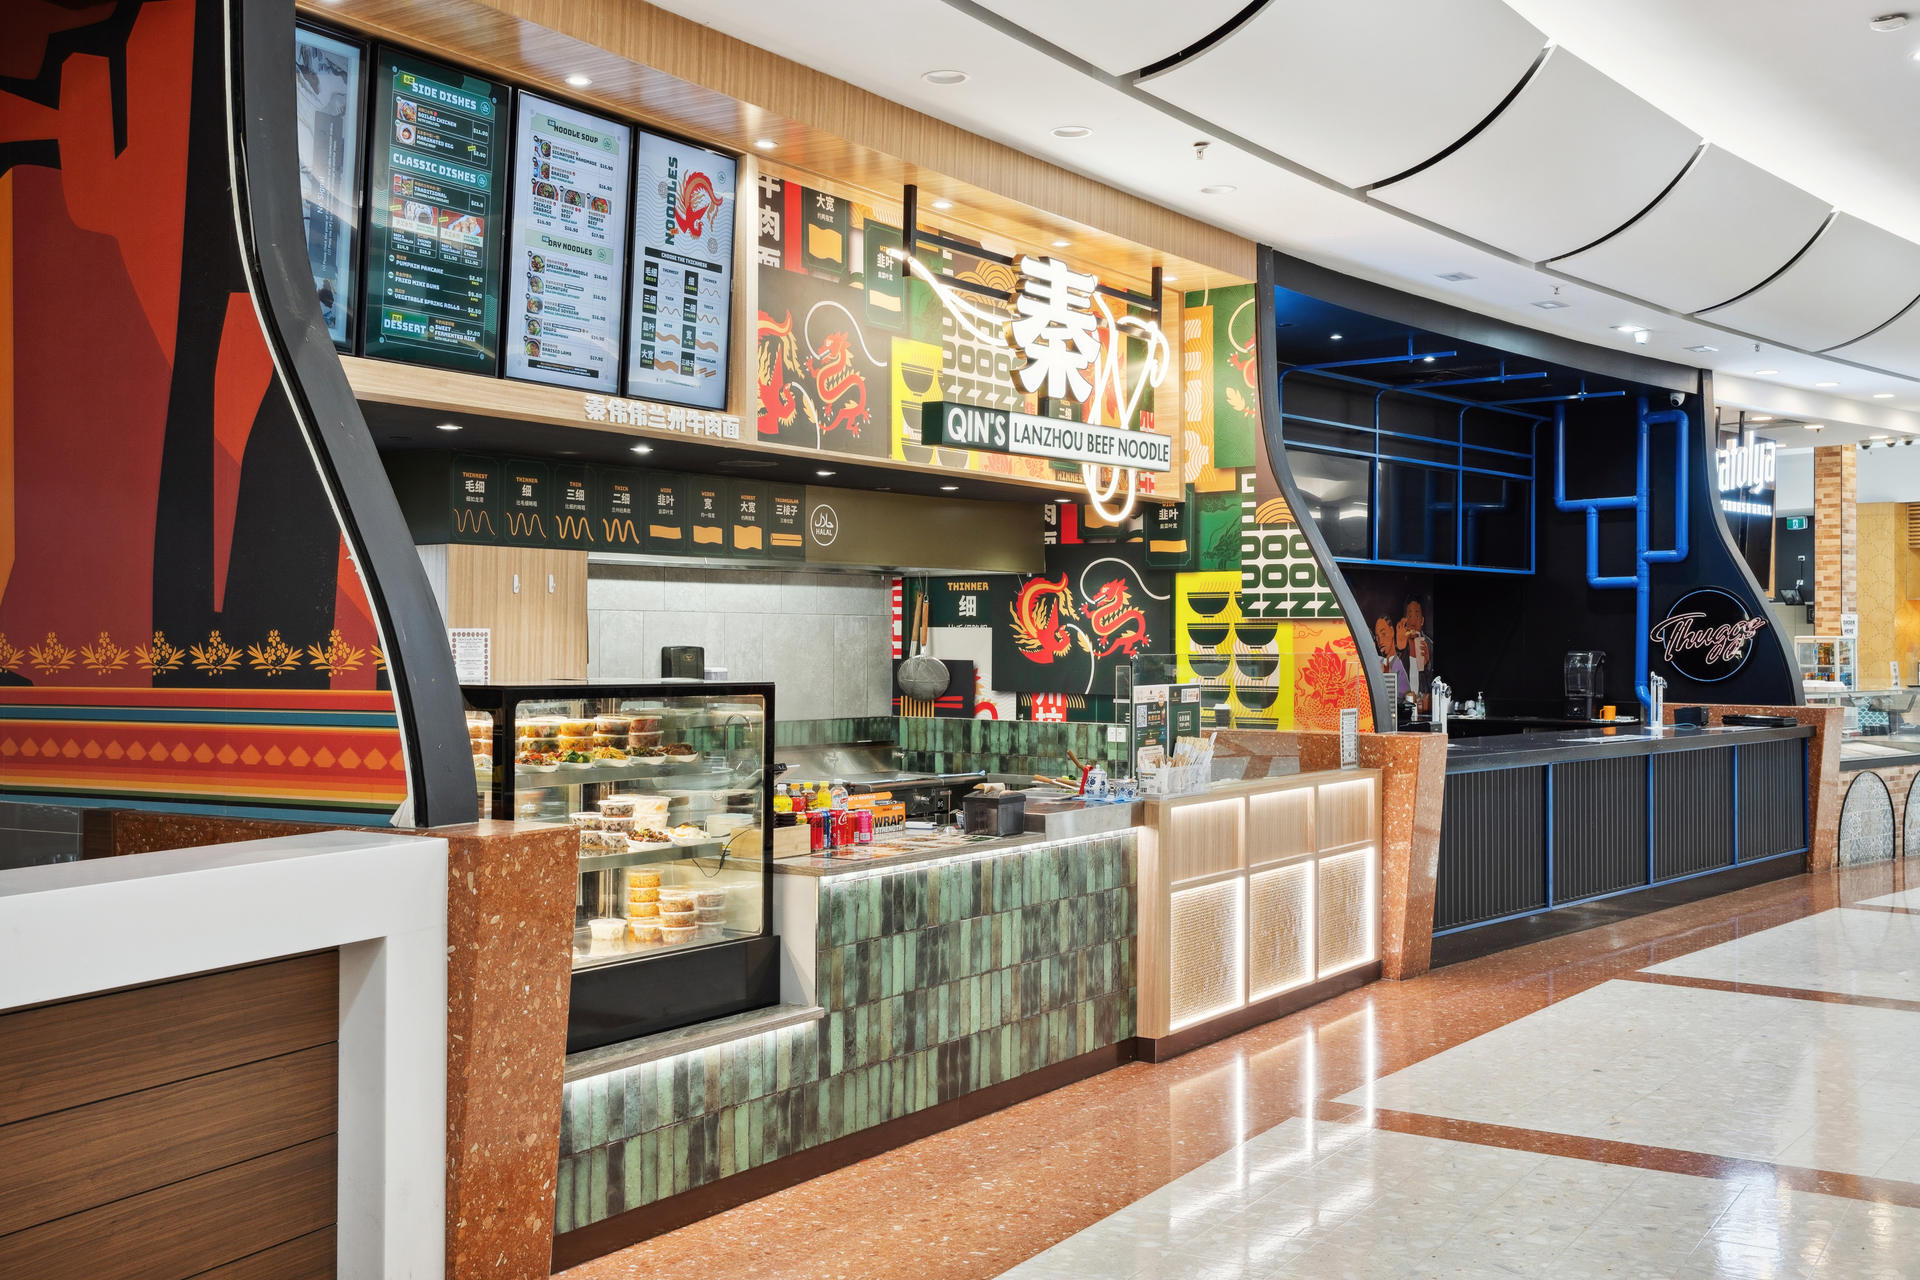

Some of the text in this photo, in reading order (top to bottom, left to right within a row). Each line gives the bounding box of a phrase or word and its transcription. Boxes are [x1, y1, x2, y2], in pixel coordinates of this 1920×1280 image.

[412, 82, 476, 110] SIDE DISHES
[554, 125, 598, 144] NOODLE SOUP
[393, 153, 476, 184] CLASSIC DISHES
[665, 156, 678, 246] NOODLES
[816, 194, 834, 212] 大宽
[548, 240, 592, 256] DRY NOODLES
[876, 252, 894, 270] 韭叶
[384, 319, 426, 334] DESSERT
[1004, 255, 1101, 403] 秦
[947, 407, 1168, 462] QIN'S LANZHOU BEEF NOODLE
[463, 472, 488, 480] THINNEST
[465, 480, 485, 494] 毛细
[522, 484, 532, 497] 细
[566, 489, 584, 502] 三细
[612, 492, 630, 505] 二细
[658, 494, 674, 507] 韭叶
[704, 498, 712, 510] 宽
[740, 501, 756, 514] 大宽
[776, 504, 798, 516] 三棱子
[814, 512, 834, 528] حلال
[1159, 508, 1178, 520] 韭叶
[816, 528, 832, 536] HALAL
[948, 582, 988, 592] THINNER
[958, 595, 977, 617] 细
[1650, 612, 1766, 664] Thuggs
[874, 814, 904, 828] WRAP
